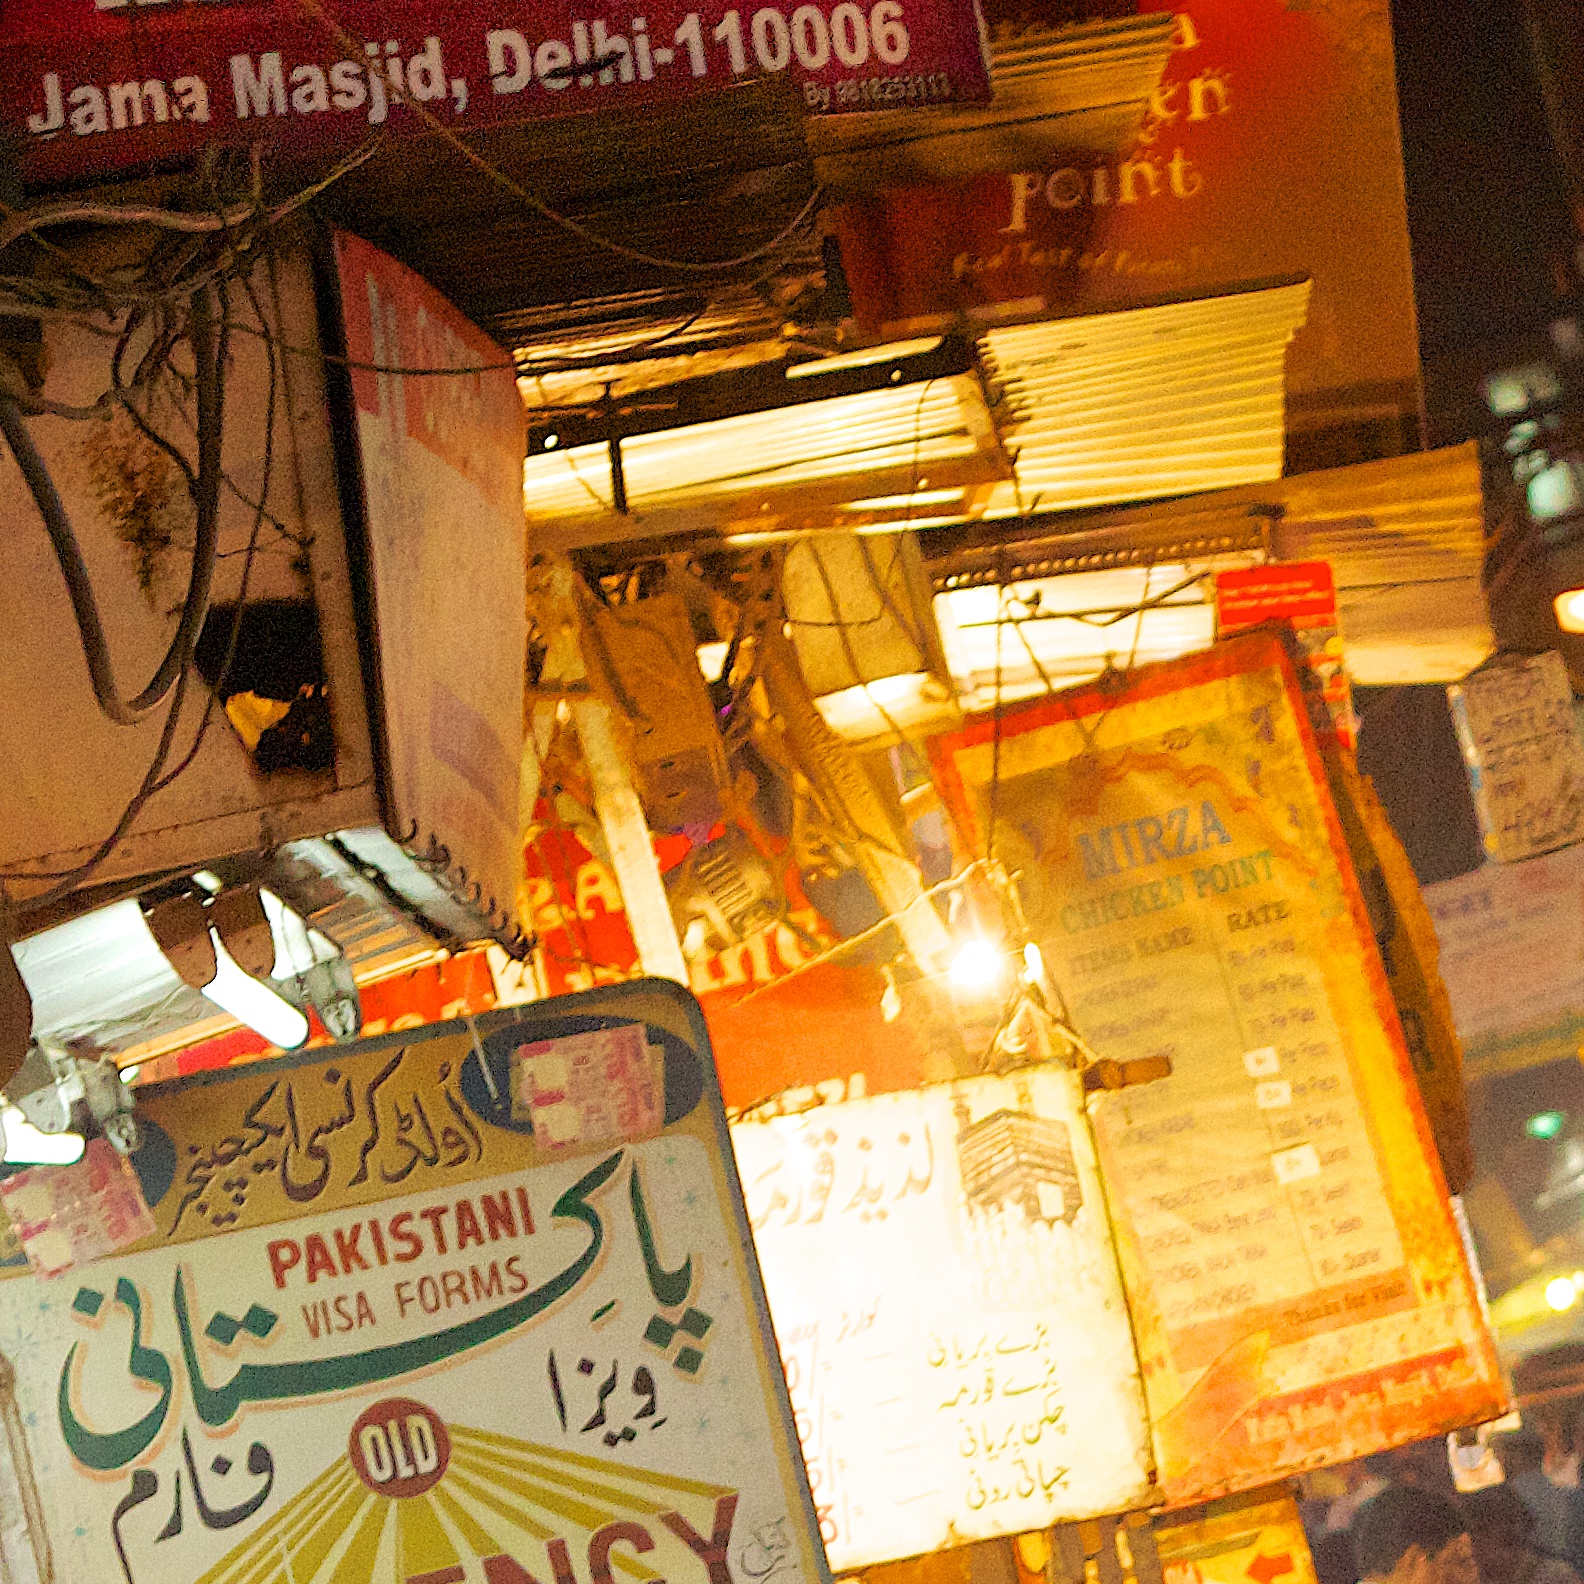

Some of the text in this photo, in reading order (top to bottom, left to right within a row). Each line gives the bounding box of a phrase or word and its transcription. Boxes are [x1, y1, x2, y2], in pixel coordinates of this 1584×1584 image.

[28, 2, 910, 138] Jama Masjid, Delhi-110006
[1077, 800, 1232, 882] MIRZA
[1191, 849, 1275, 898] POINT
[267, 1186, 537, 1289] PAKISTANI
[300, 1255, 530, 1340] VISA FORMS
[359, 1413, 439, 1485] OLD
